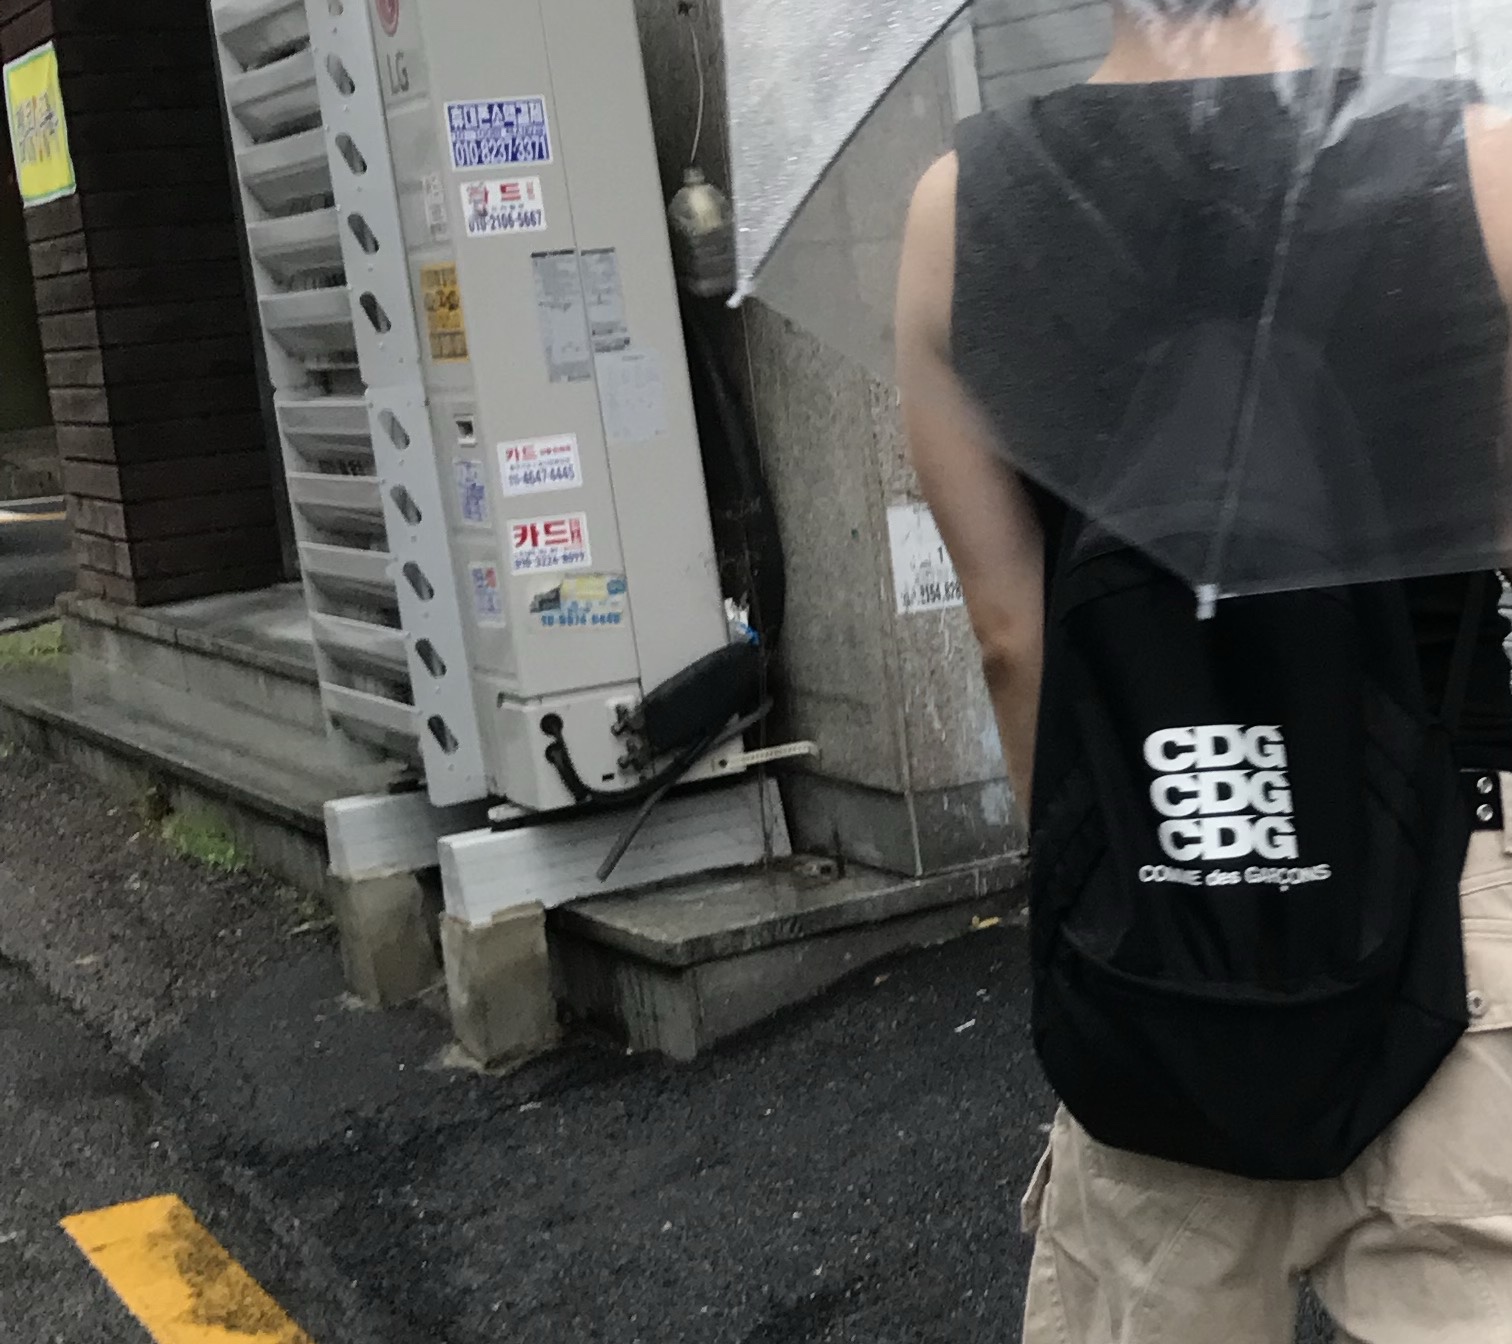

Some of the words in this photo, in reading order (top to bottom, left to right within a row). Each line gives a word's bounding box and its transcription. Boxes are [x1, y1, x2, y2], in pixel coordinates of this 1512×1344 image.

[386, 50, 409, 96] LG
[505, 444, 537, 462] 카드
[513, 520, 569, 548] 카드
[1143, 724, 1288, 772] CDG
[1150, 770, 1294, 817] CDG
[1157, 815, 1299, 862] CDG
[1205, 868, 1242, 886] des
